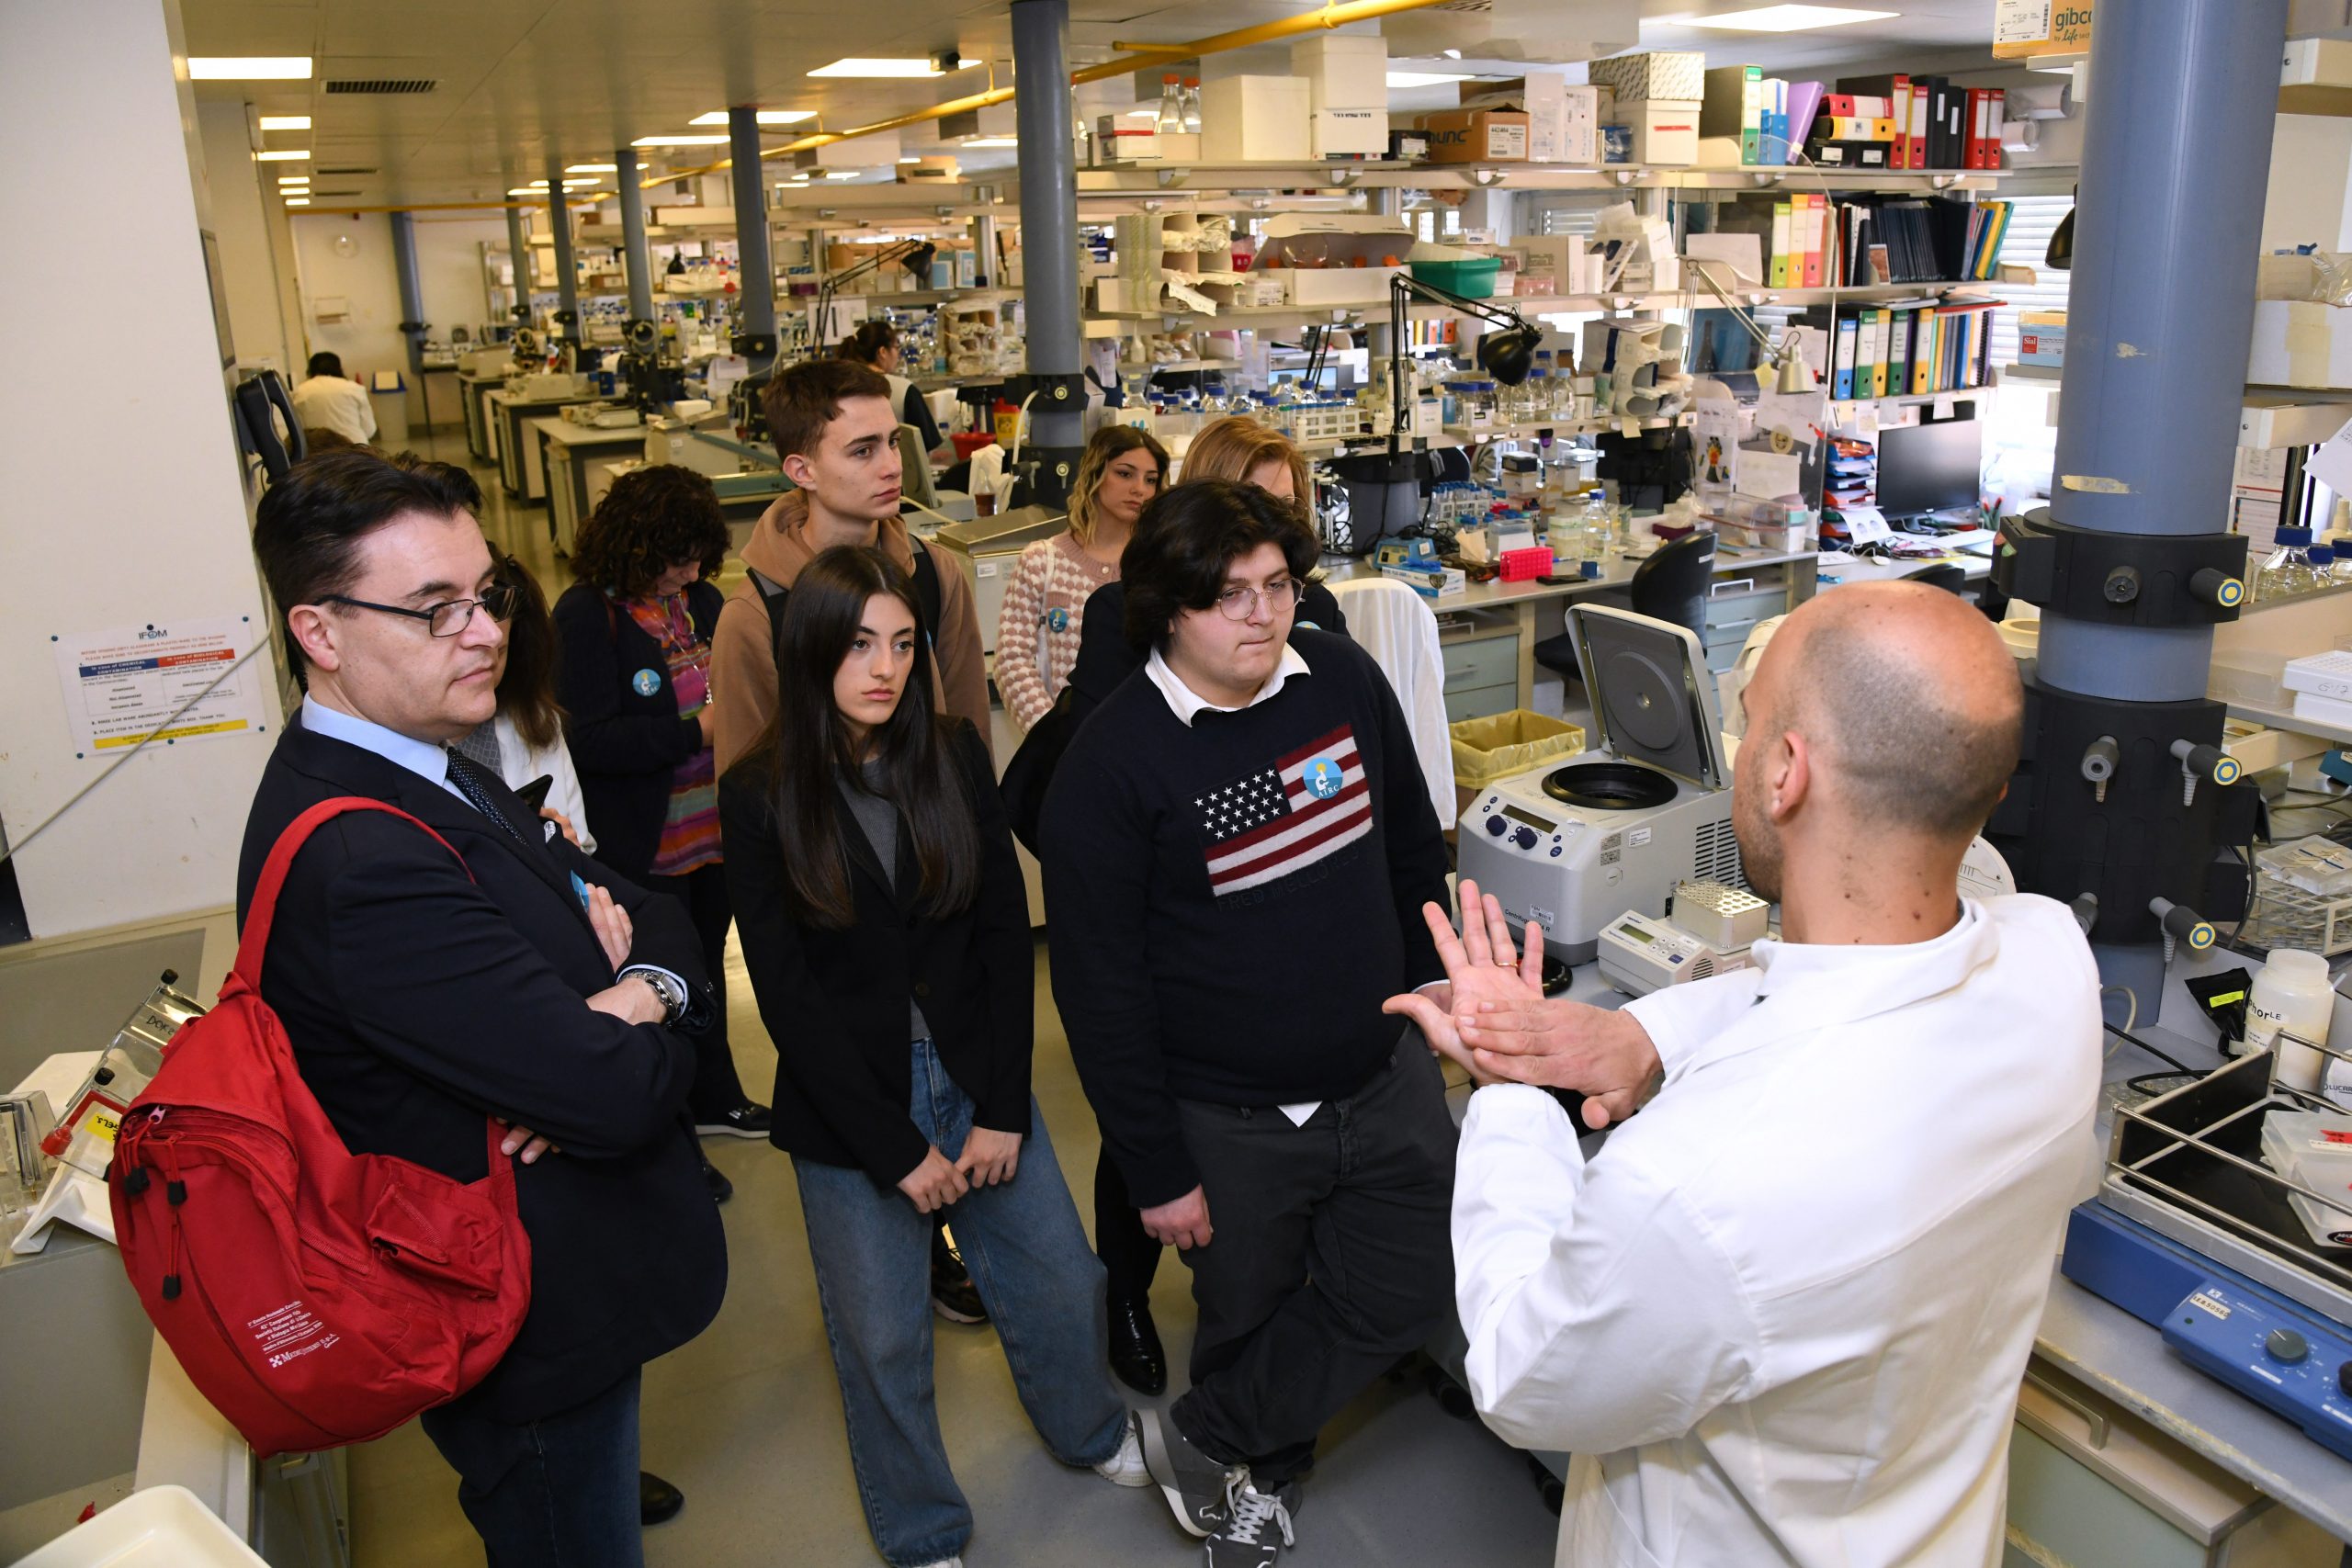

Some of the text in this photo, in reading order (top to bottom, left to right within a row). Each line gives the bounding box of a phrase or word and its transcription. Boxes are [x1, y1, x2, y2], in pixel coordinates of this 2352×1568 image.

[2061, 28, 2078, 45] life
[138, 629, 168, 640] IFOM
[1319, 785, 1339, 798] AIRC
